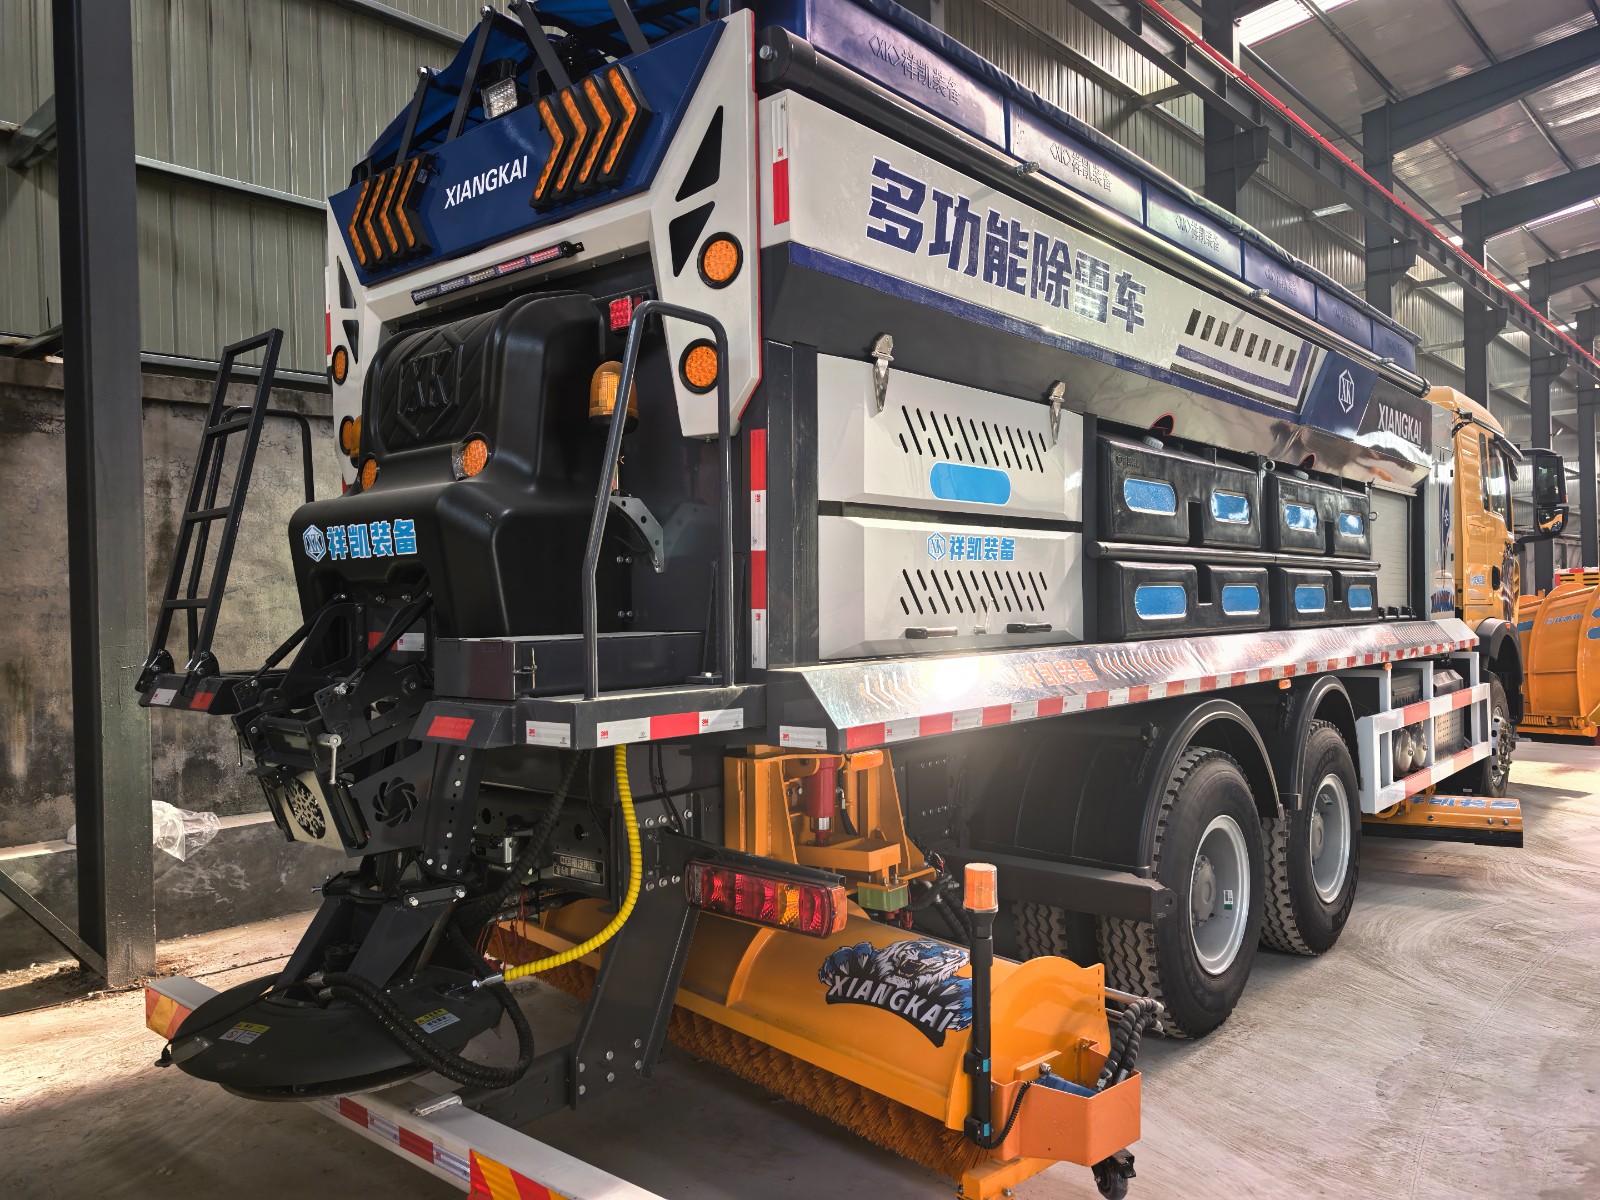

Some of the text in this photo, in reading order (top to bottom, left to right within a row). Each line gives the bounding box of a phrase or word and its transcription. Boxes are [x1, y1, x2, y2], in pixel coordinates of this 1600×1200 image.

[443, 154, 528, 210] XIANGKAI
[866, 155, 1147, 334] 多功能除雪车
[1378, 402, 1422, 444] XIANGKAI
[327, 519, 418, 560] 祥凯装备
[948, 534, 1015, 561] 祥凯装备
[828, 975, 955, 1033] XIANGKAI
